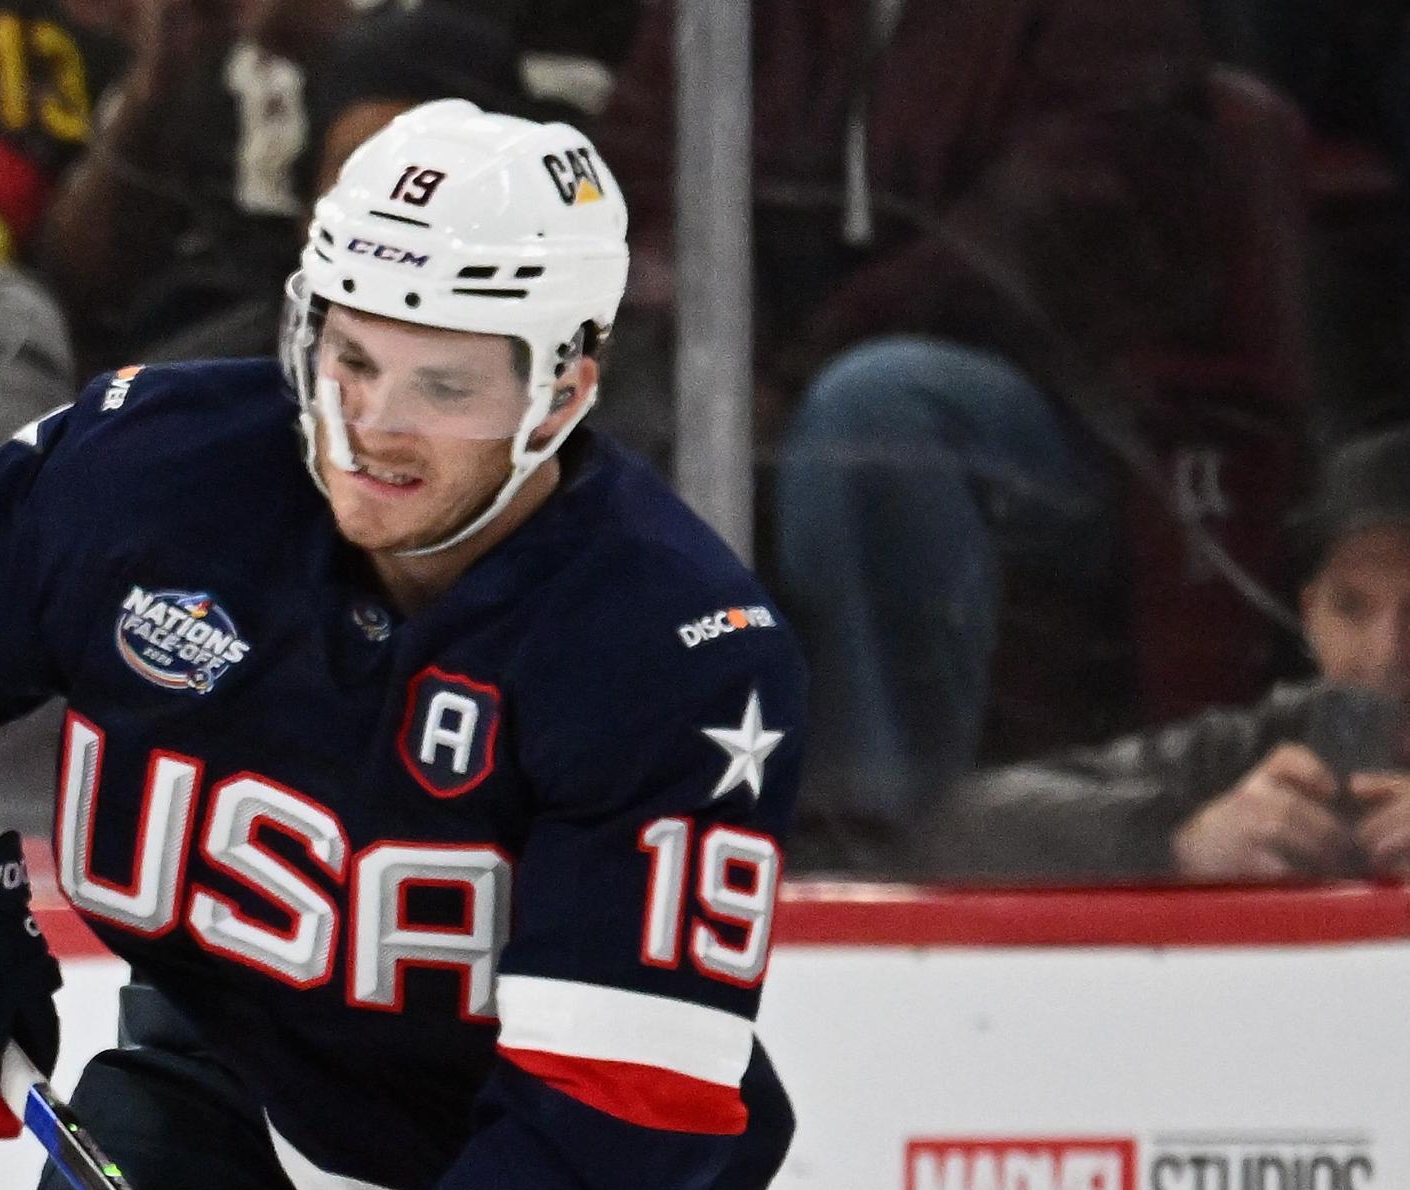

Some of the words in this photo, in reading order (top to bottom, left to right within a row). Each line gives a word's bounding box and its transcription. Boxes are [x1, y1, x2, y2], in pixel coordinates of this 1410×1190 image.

[389, 165, 447, 208] 19
[542, 147, 605, 207] CAT
[347, 238, 430, 268] CCM
[123, 585, 250, 664] NATIONS
[420, 691, 478, 775] A
[55, 709, 515, 1024] USA
[637, 814, 783, 990] 19
